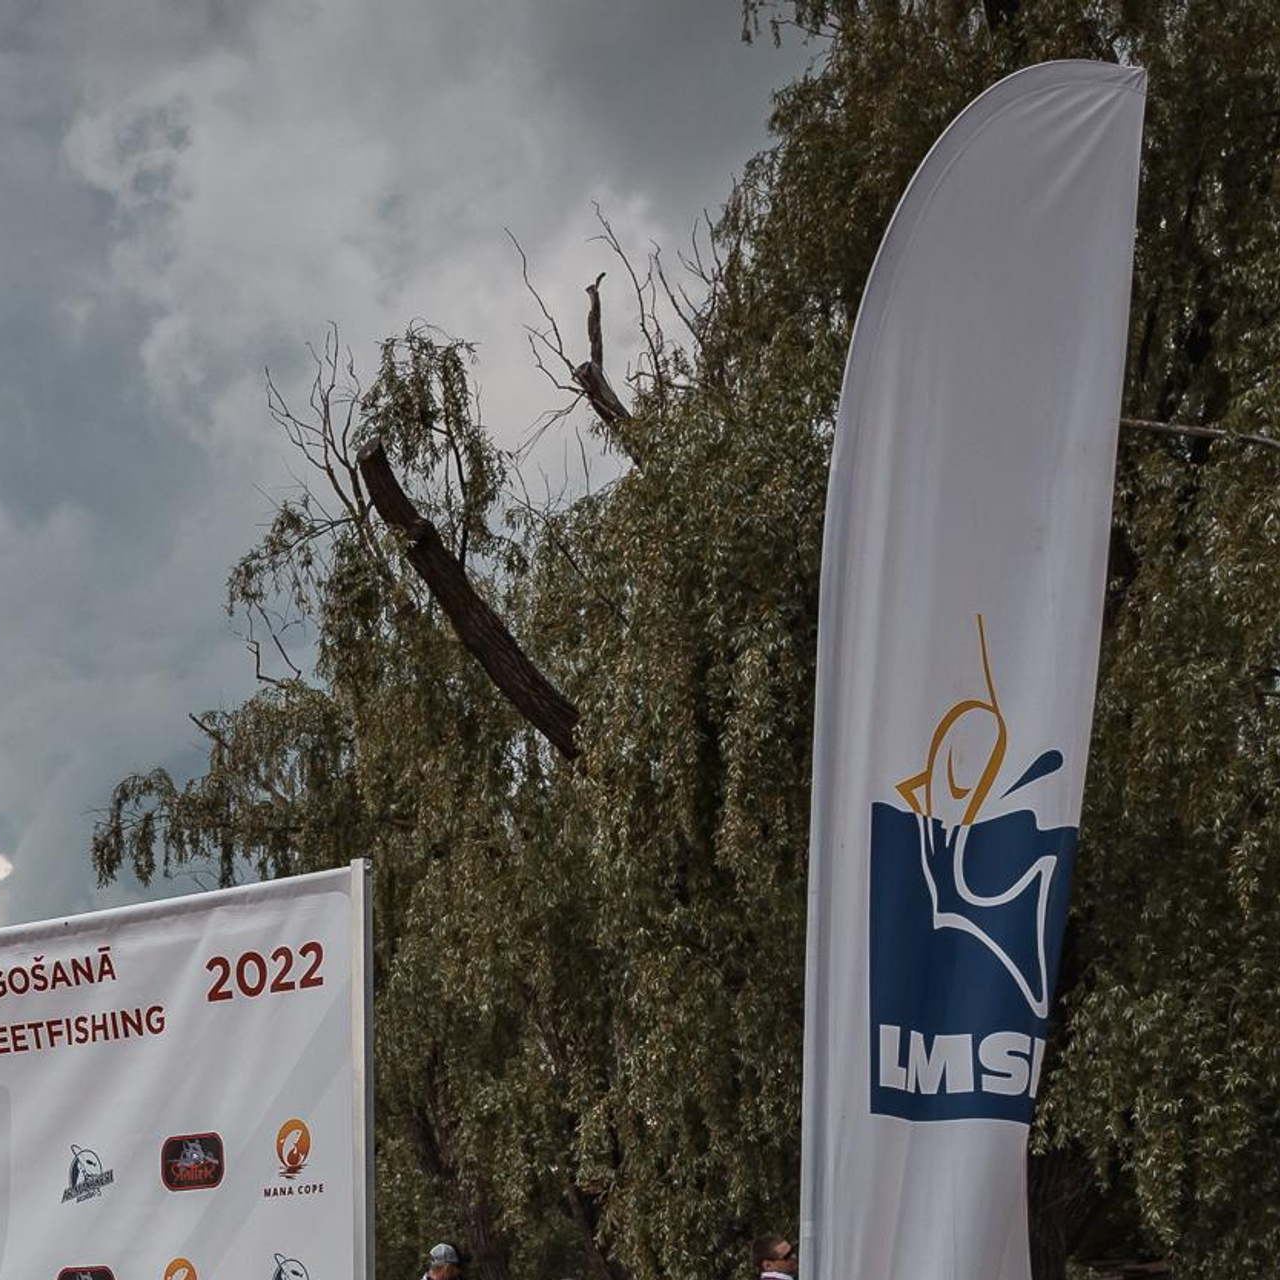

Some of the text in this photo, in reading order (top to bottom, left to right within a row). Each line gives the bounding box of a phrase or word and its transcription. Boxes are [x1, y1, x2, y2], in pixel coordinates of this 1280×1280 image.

[205, 940, 325, 1003] 2022
[263, 1184, 324, 1198] MANA COPE
